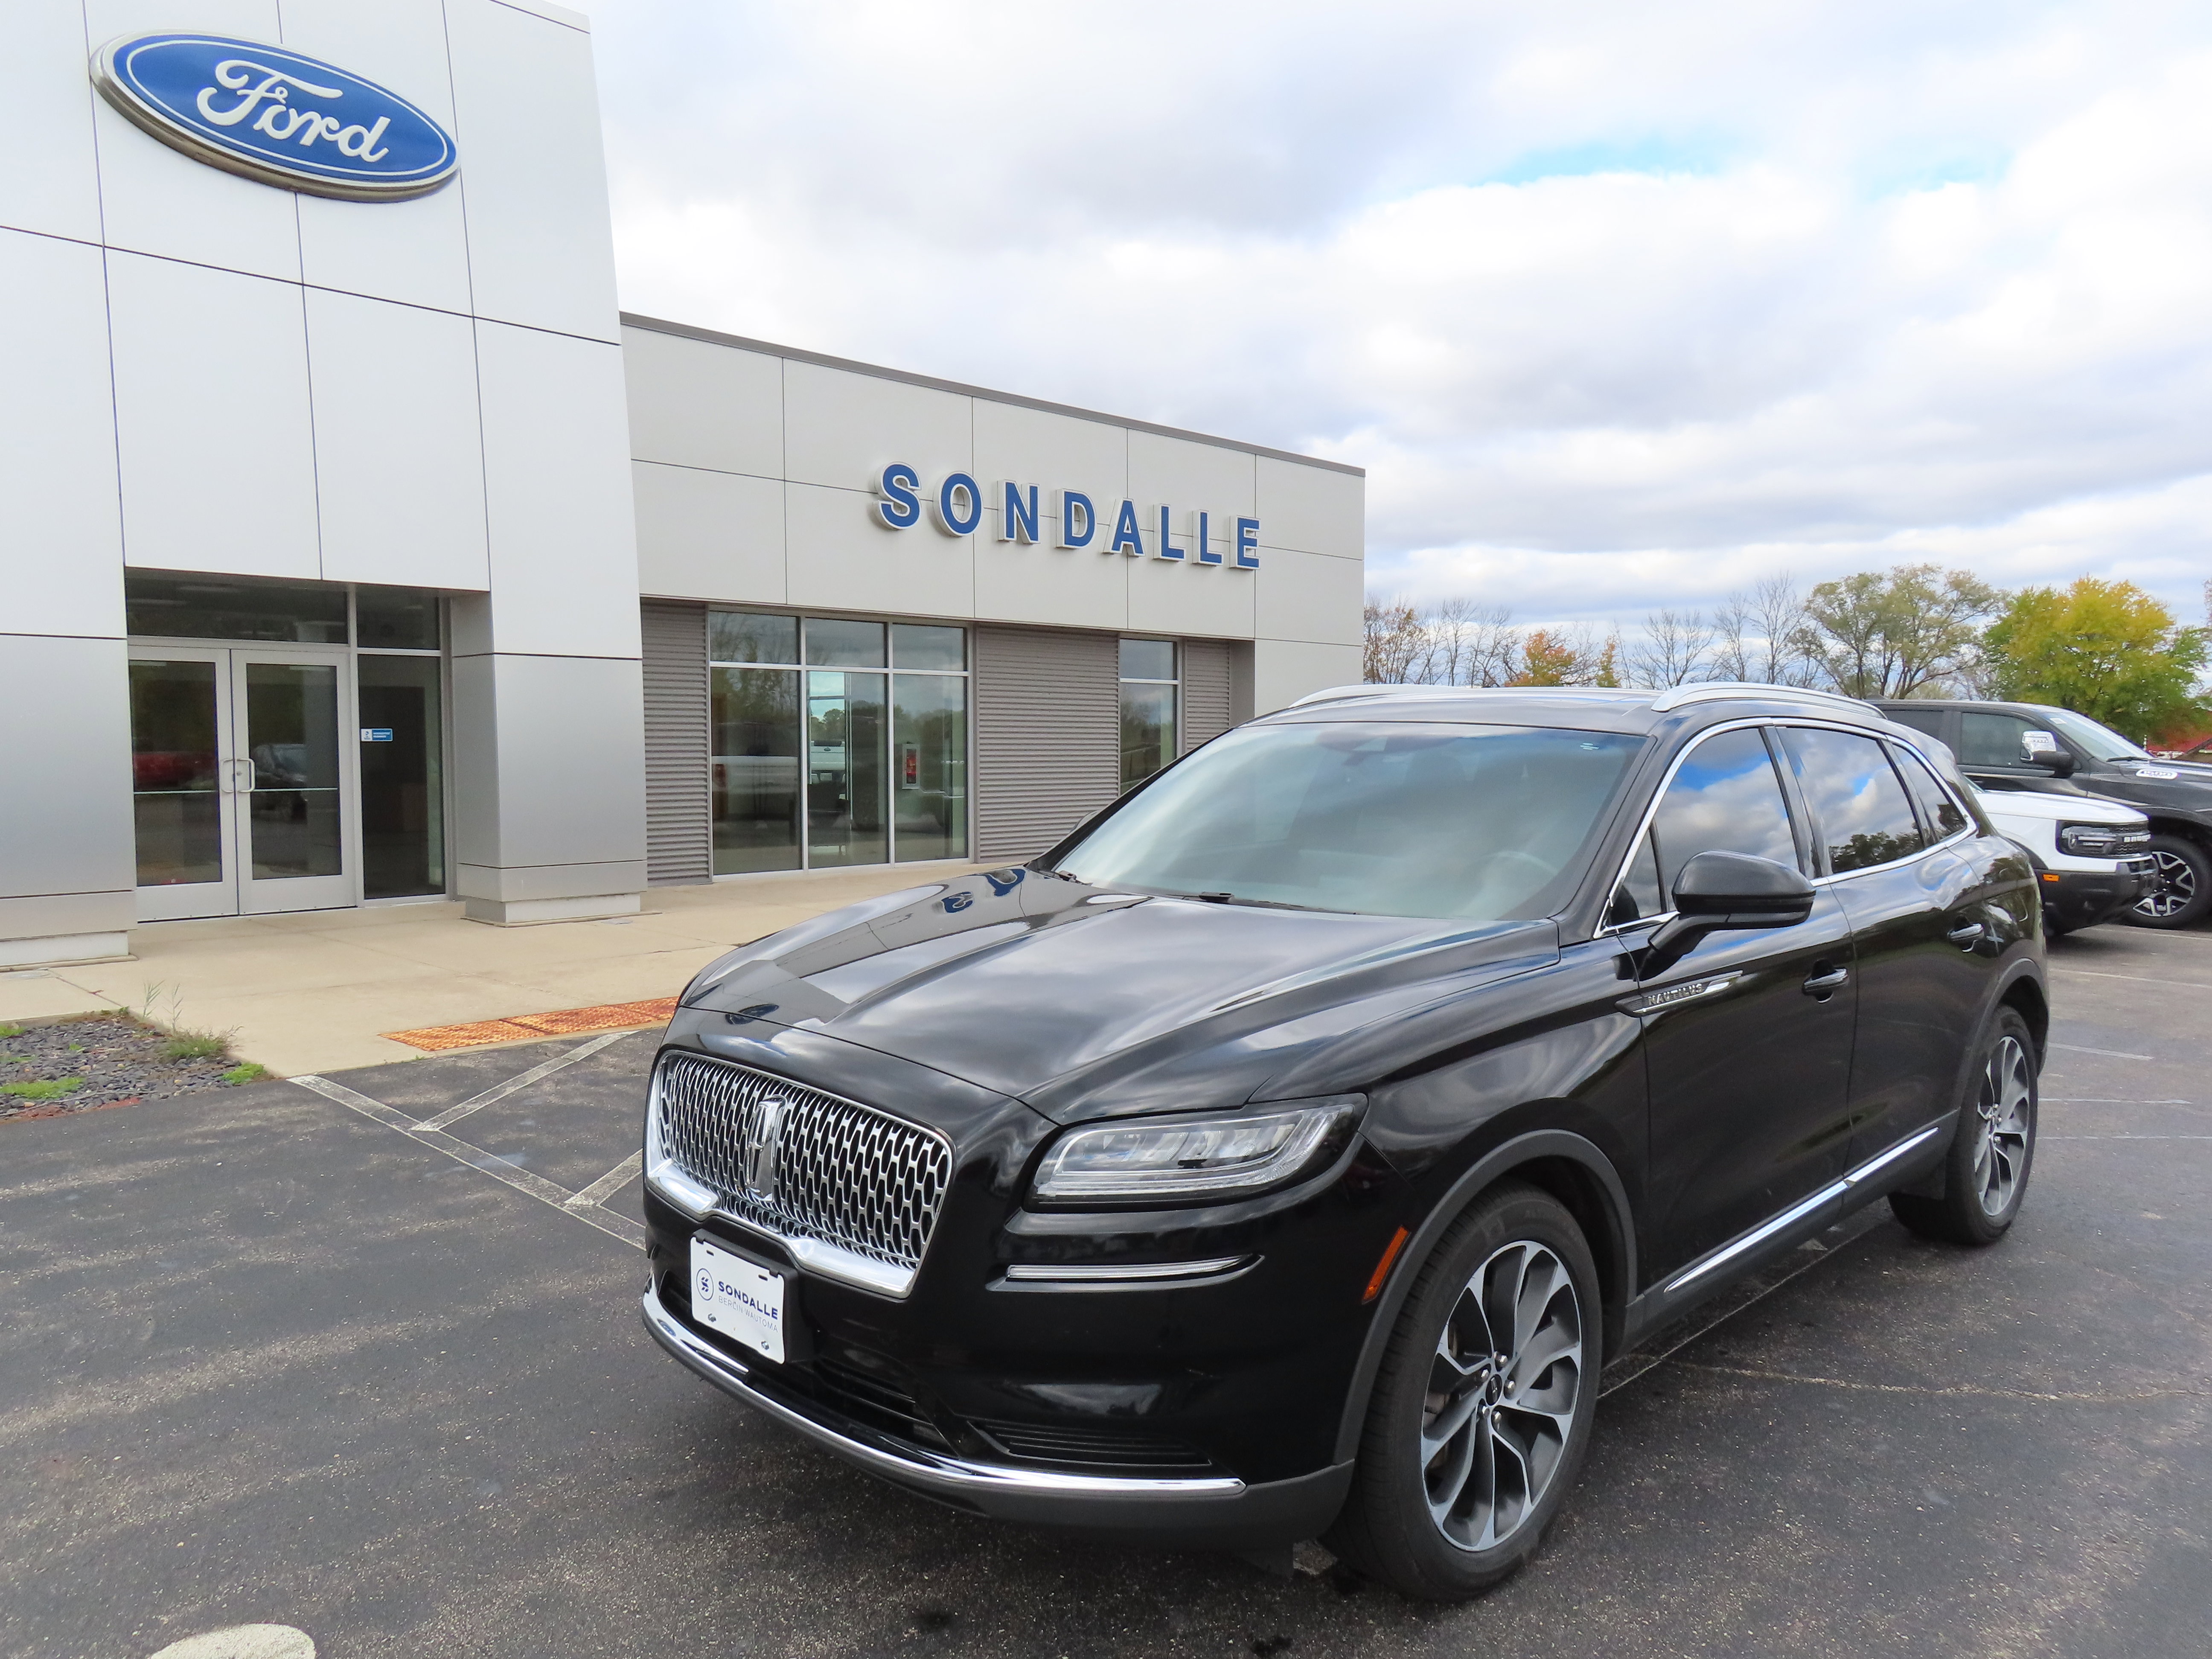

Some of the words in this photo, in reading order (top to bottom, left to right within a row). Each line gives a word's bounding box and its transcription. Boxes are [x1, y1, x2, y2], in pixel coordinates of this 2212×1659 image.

[196, 59, 391, 163] Ford
[875, 462, 1261, 570] SONDALLE
[1647, 983, 1702, 1006] NAUTILUS
[719, 1281, 778, 1320] SONDALLE
